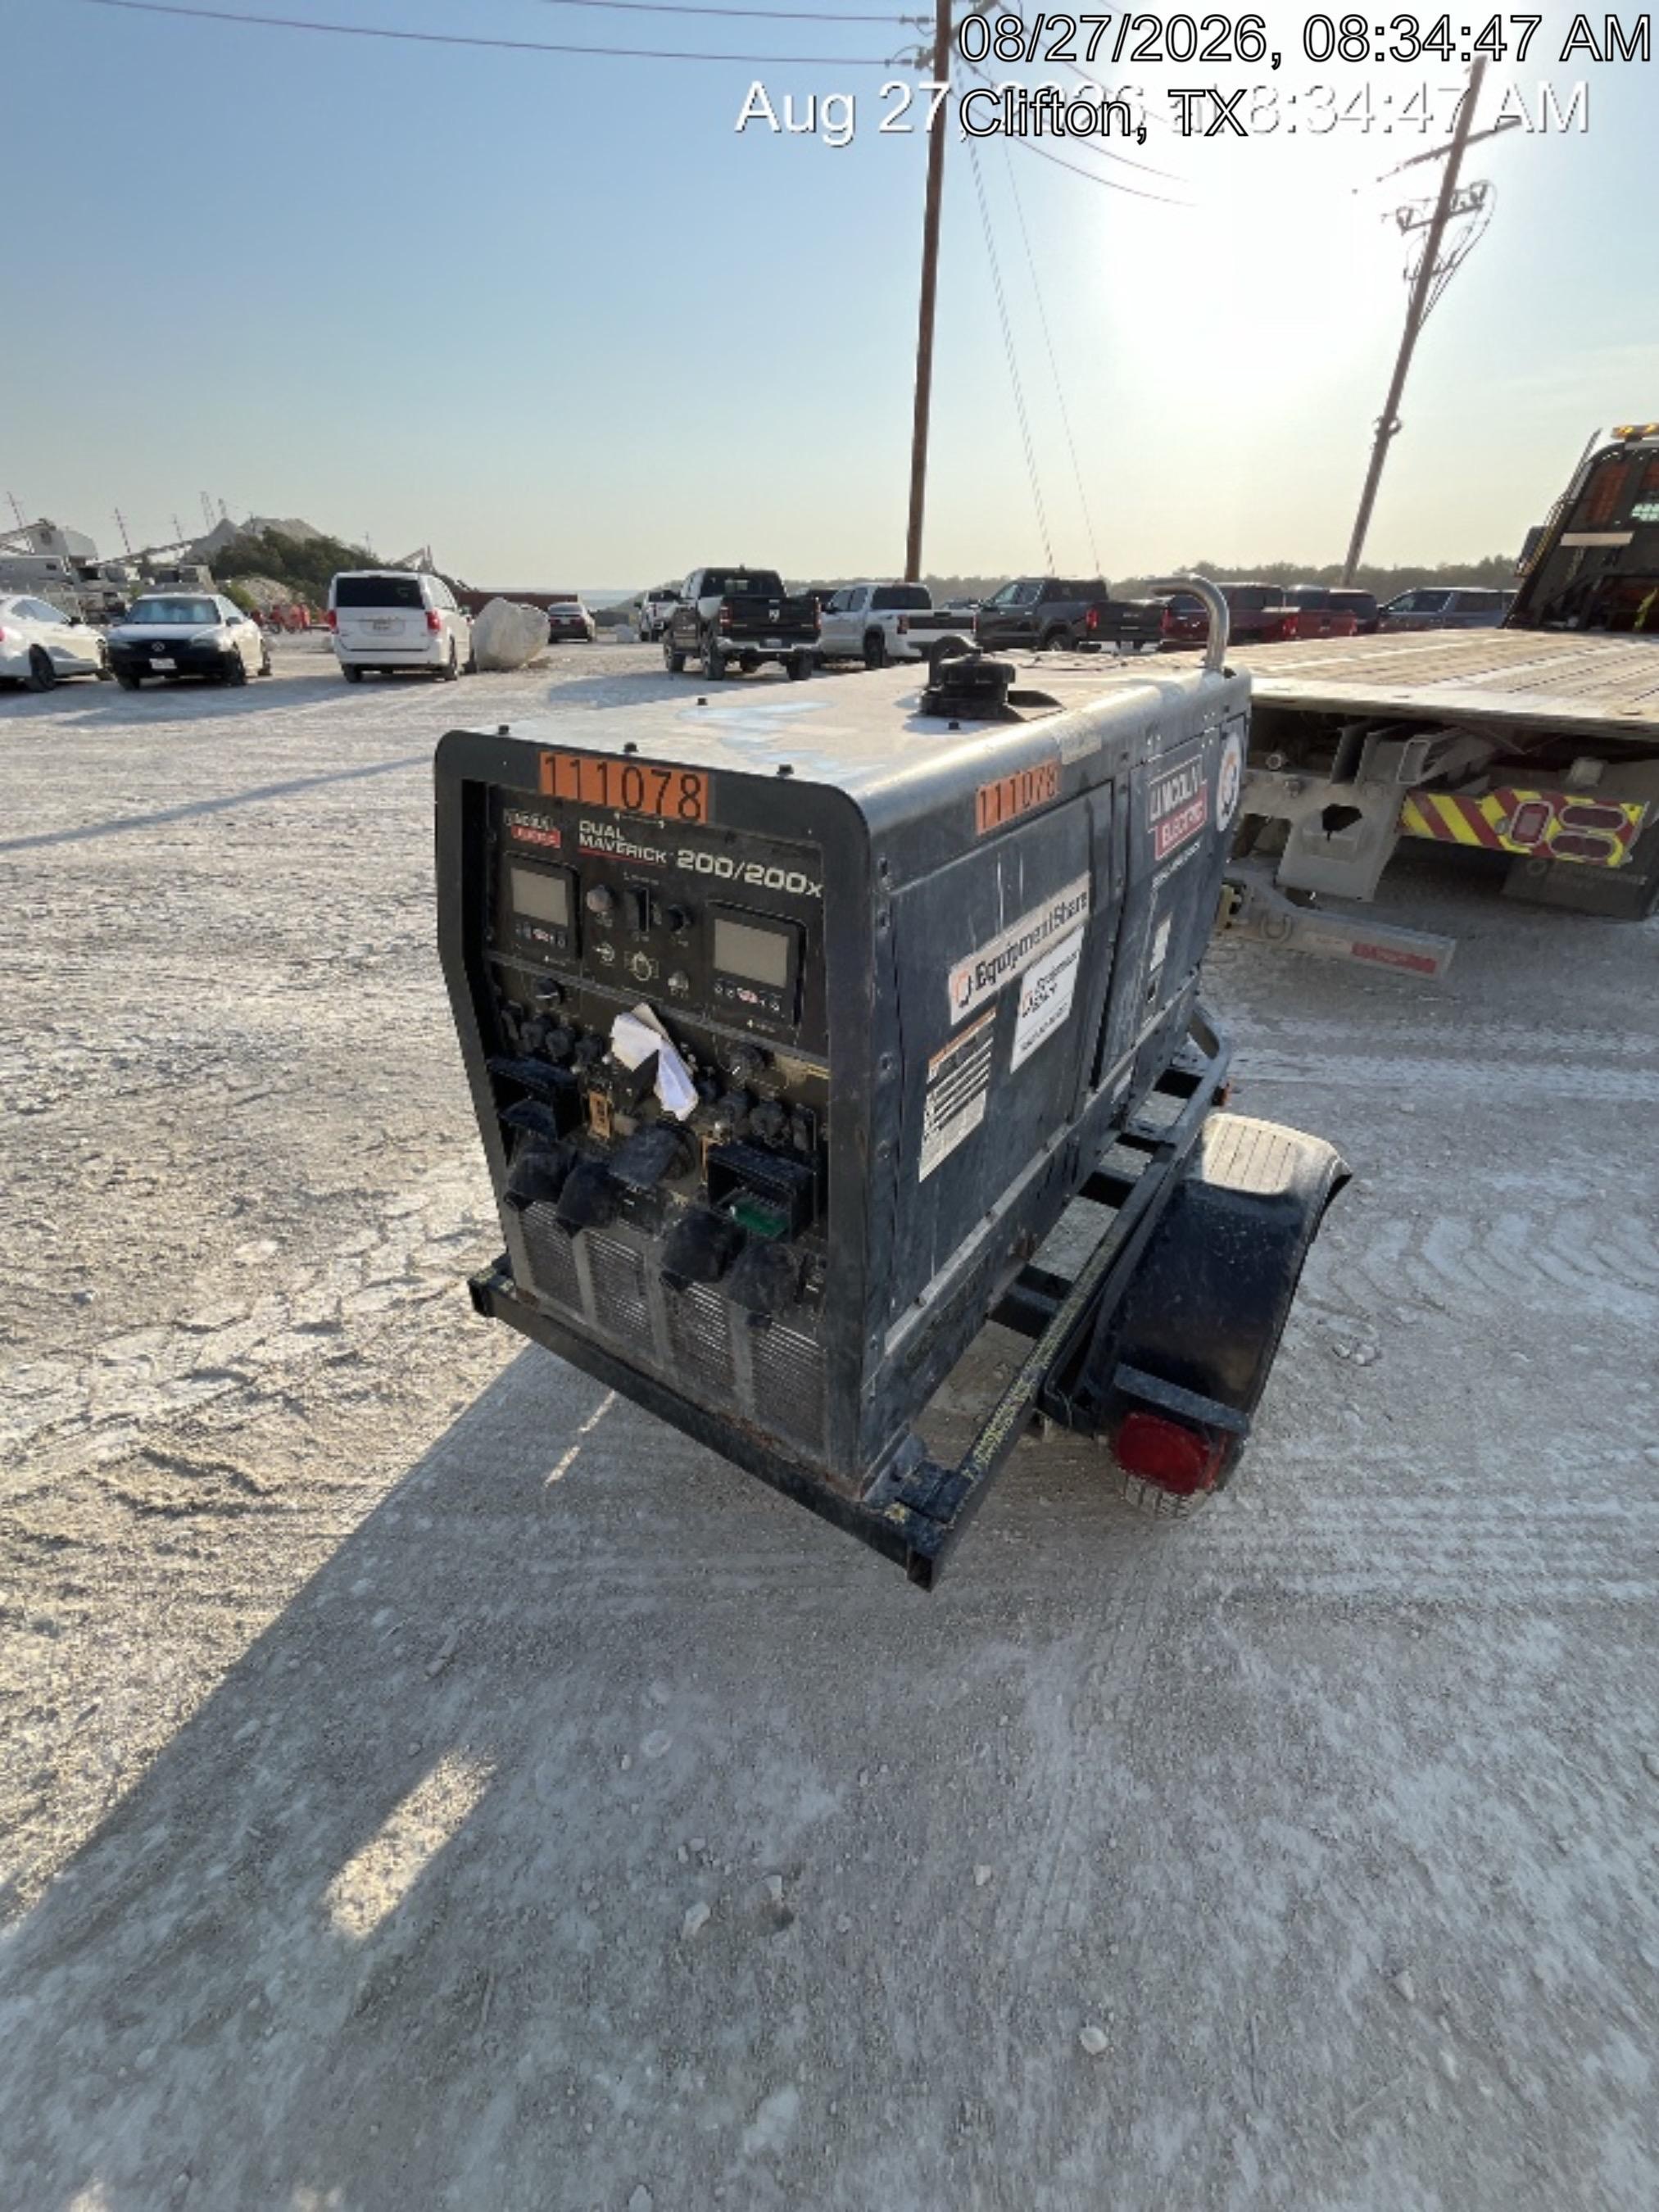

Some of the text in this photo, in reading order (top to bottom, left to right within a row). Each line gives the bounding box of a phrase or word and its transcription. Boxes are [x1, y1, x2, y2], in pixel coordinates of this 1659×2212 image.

[544, 755, 701, 819] 111078
[980, 764, 1056, 830] 111078
[579, 820, 625, 842] DUAL
[579, 832, 668, 864] MAVERICK
[975, 891, 1088, 991] EquipmentShare
